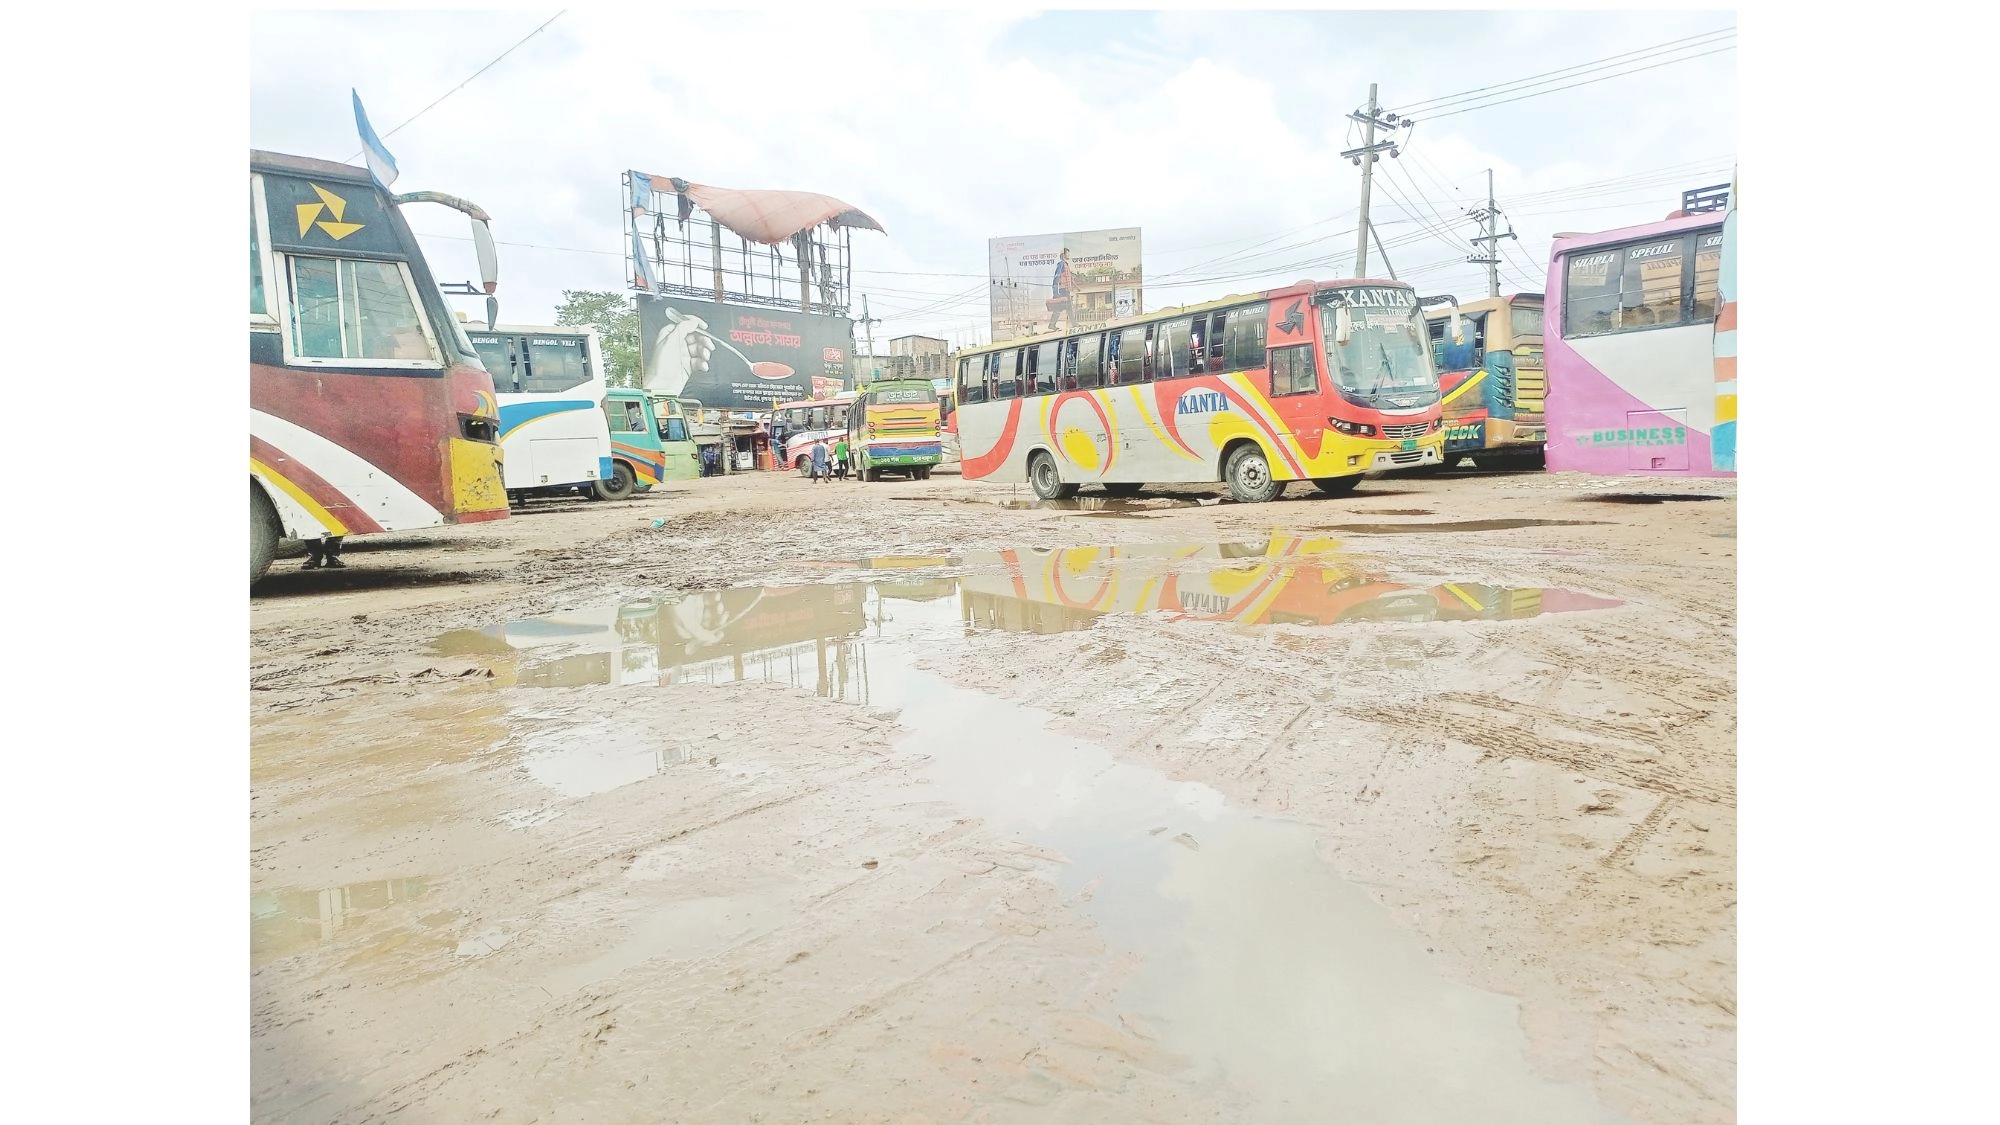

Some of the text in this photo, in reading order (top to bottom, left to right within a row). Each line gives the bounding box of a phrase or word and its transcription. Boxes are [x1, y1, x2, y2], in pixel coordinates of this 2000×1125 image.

[1573, 253, 1615, 269] SHAPLA
[1630, 243, 1675, 260] SPECIAL
[1338, 289, 1409, 308] KANTA
[472, 337, 499, 345] BENGOL
[532, 338, 559, 346] BENGOL
[1177, 391, 1230, 414] KANTA
[1593, 426, 1686, 443] BUSINESS
